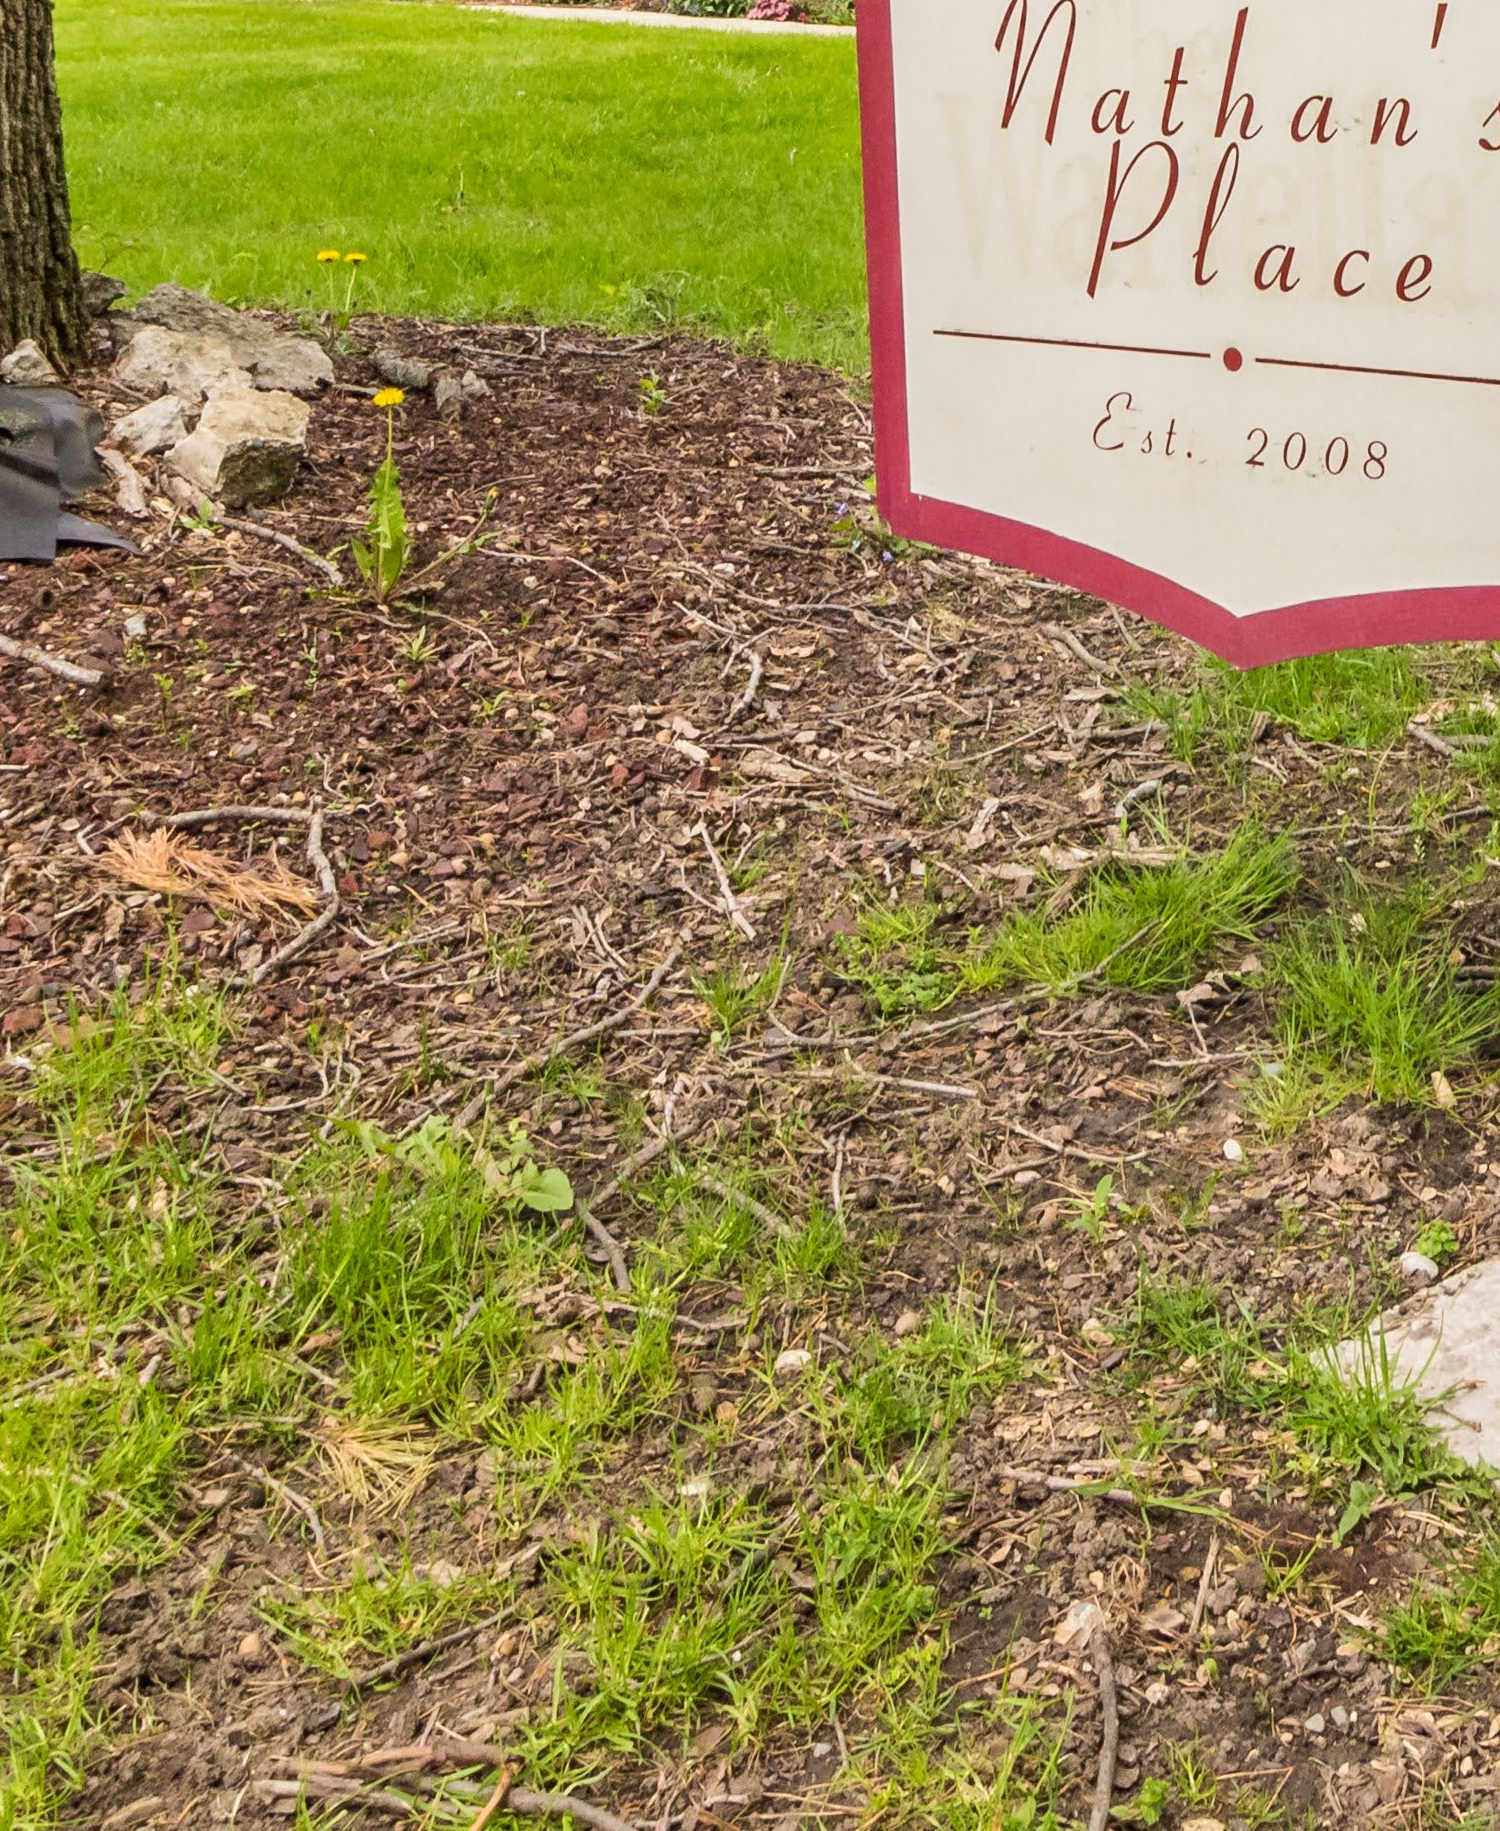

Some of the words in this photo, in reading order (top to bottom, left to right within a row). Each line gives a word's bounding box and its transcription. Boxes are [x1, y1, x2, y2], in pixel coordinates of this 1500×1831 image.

[1086, 140, 1434, 304] Place
[1091, 390, 1195, 461] Est.
[1245, 427, 1390, 481] 2008
